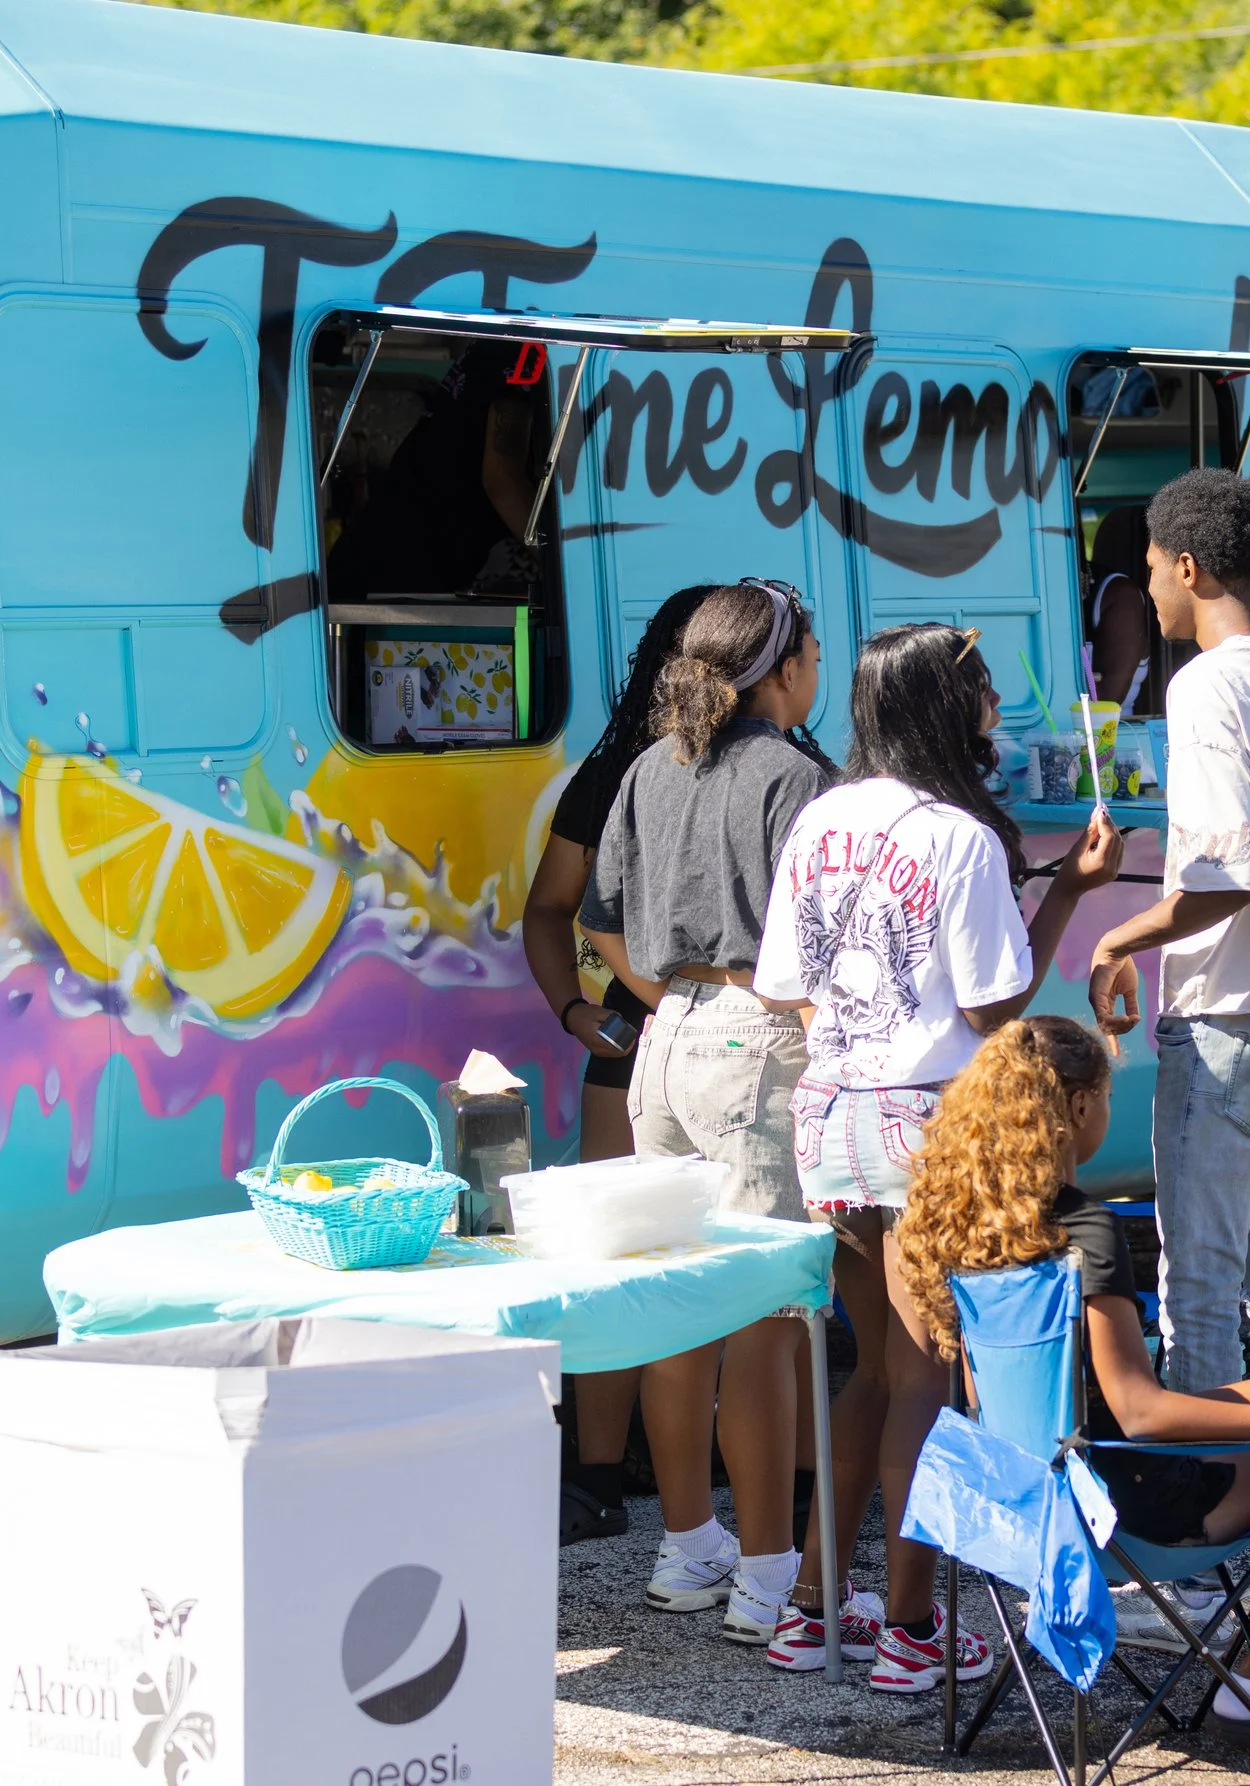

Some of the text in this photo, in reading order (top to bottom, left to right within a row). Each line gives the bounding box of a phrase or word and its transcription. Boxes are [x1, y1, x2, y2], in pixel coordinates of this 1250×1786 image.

[374, 230, 749, 498] Tme
[403, 677, 413, 716] NITRILE
[8, 1663, 121, 1721] Akron
